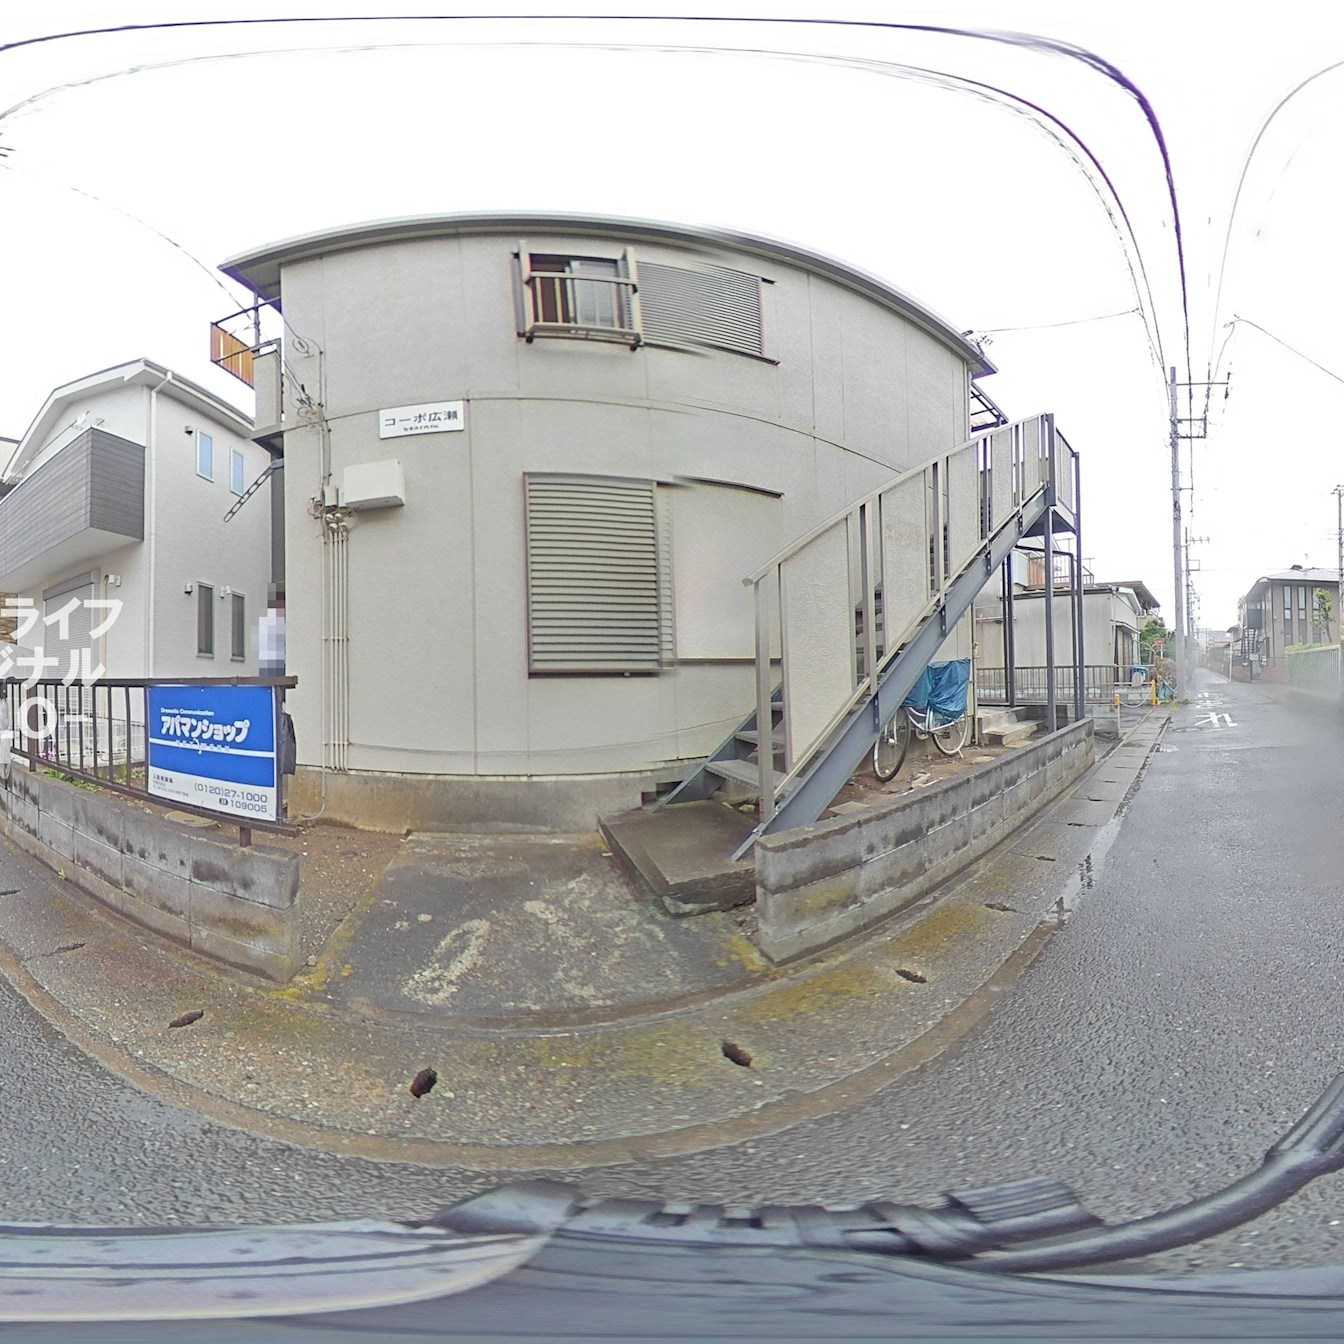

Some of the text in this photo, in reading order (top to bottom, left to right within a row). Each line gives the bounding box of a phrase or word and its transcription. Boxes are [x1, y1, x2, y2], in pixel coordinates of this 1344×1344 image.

[160, 715, 250, 743] アパマンショップ
